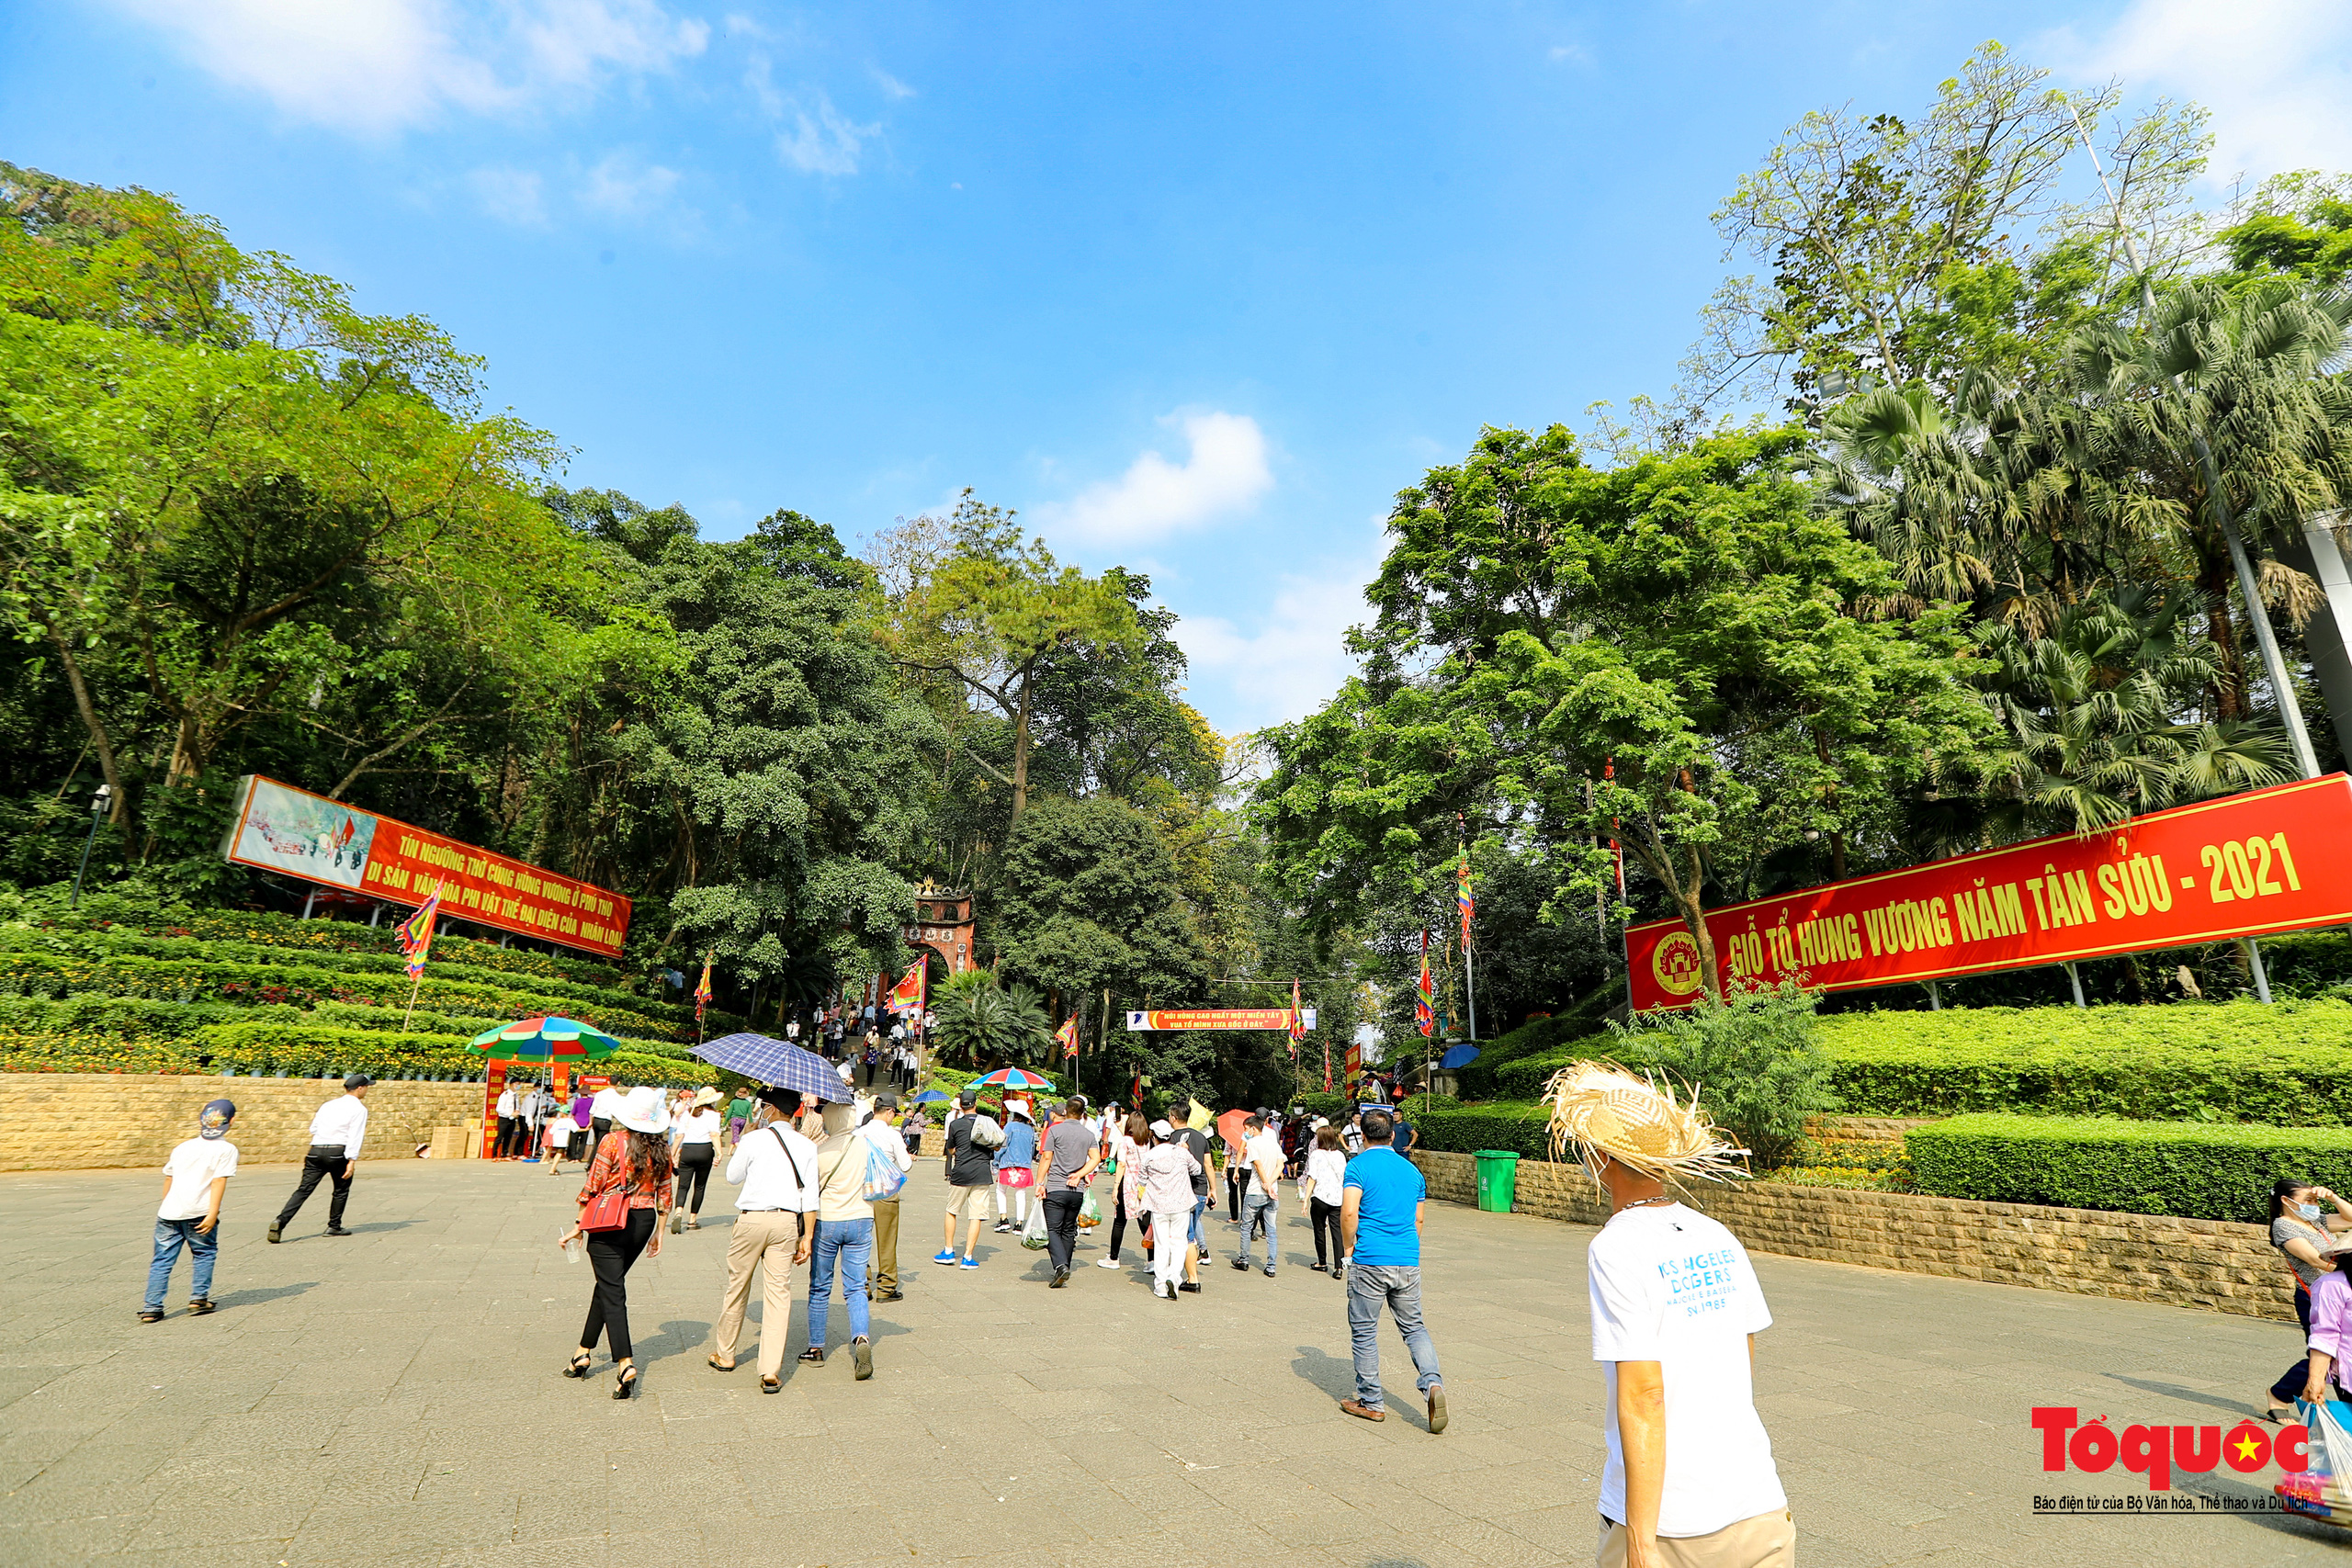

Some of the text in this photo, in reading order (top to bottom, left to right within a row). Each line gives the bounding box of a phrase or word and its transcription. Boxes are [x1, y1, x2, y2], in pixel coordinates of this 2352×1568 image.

[366, 861, 383, 883] DI
[382, 862, 411, 890] SẢN
[413, 871, 439, 897] VĂN
[460, 887, 481, 909] PHI
[481, 891, 502, 917] VẬT
[501, 896, 523, 919] THỂ
[519, 904, 537, 927] ĐẠI
[537, 908, 560, 932] DIỆN
[559, 912, 578, 935] CỦA
[580, 921, 605, 942] NHÂN
[604, 928, 623, 950] LOẠI
[399, 833, 614, 920] TÍN NGƯỠNG THỜ CÚNG HÙNG VƯƠNG Ở PHÚ THỌ
[1728, 831, 2302, 977] GIỖ TỔ HÙNG VƯƠNG NĂM TÂN SỬU - 2021
[1230, 1011, 1246, 1020] MỘT
